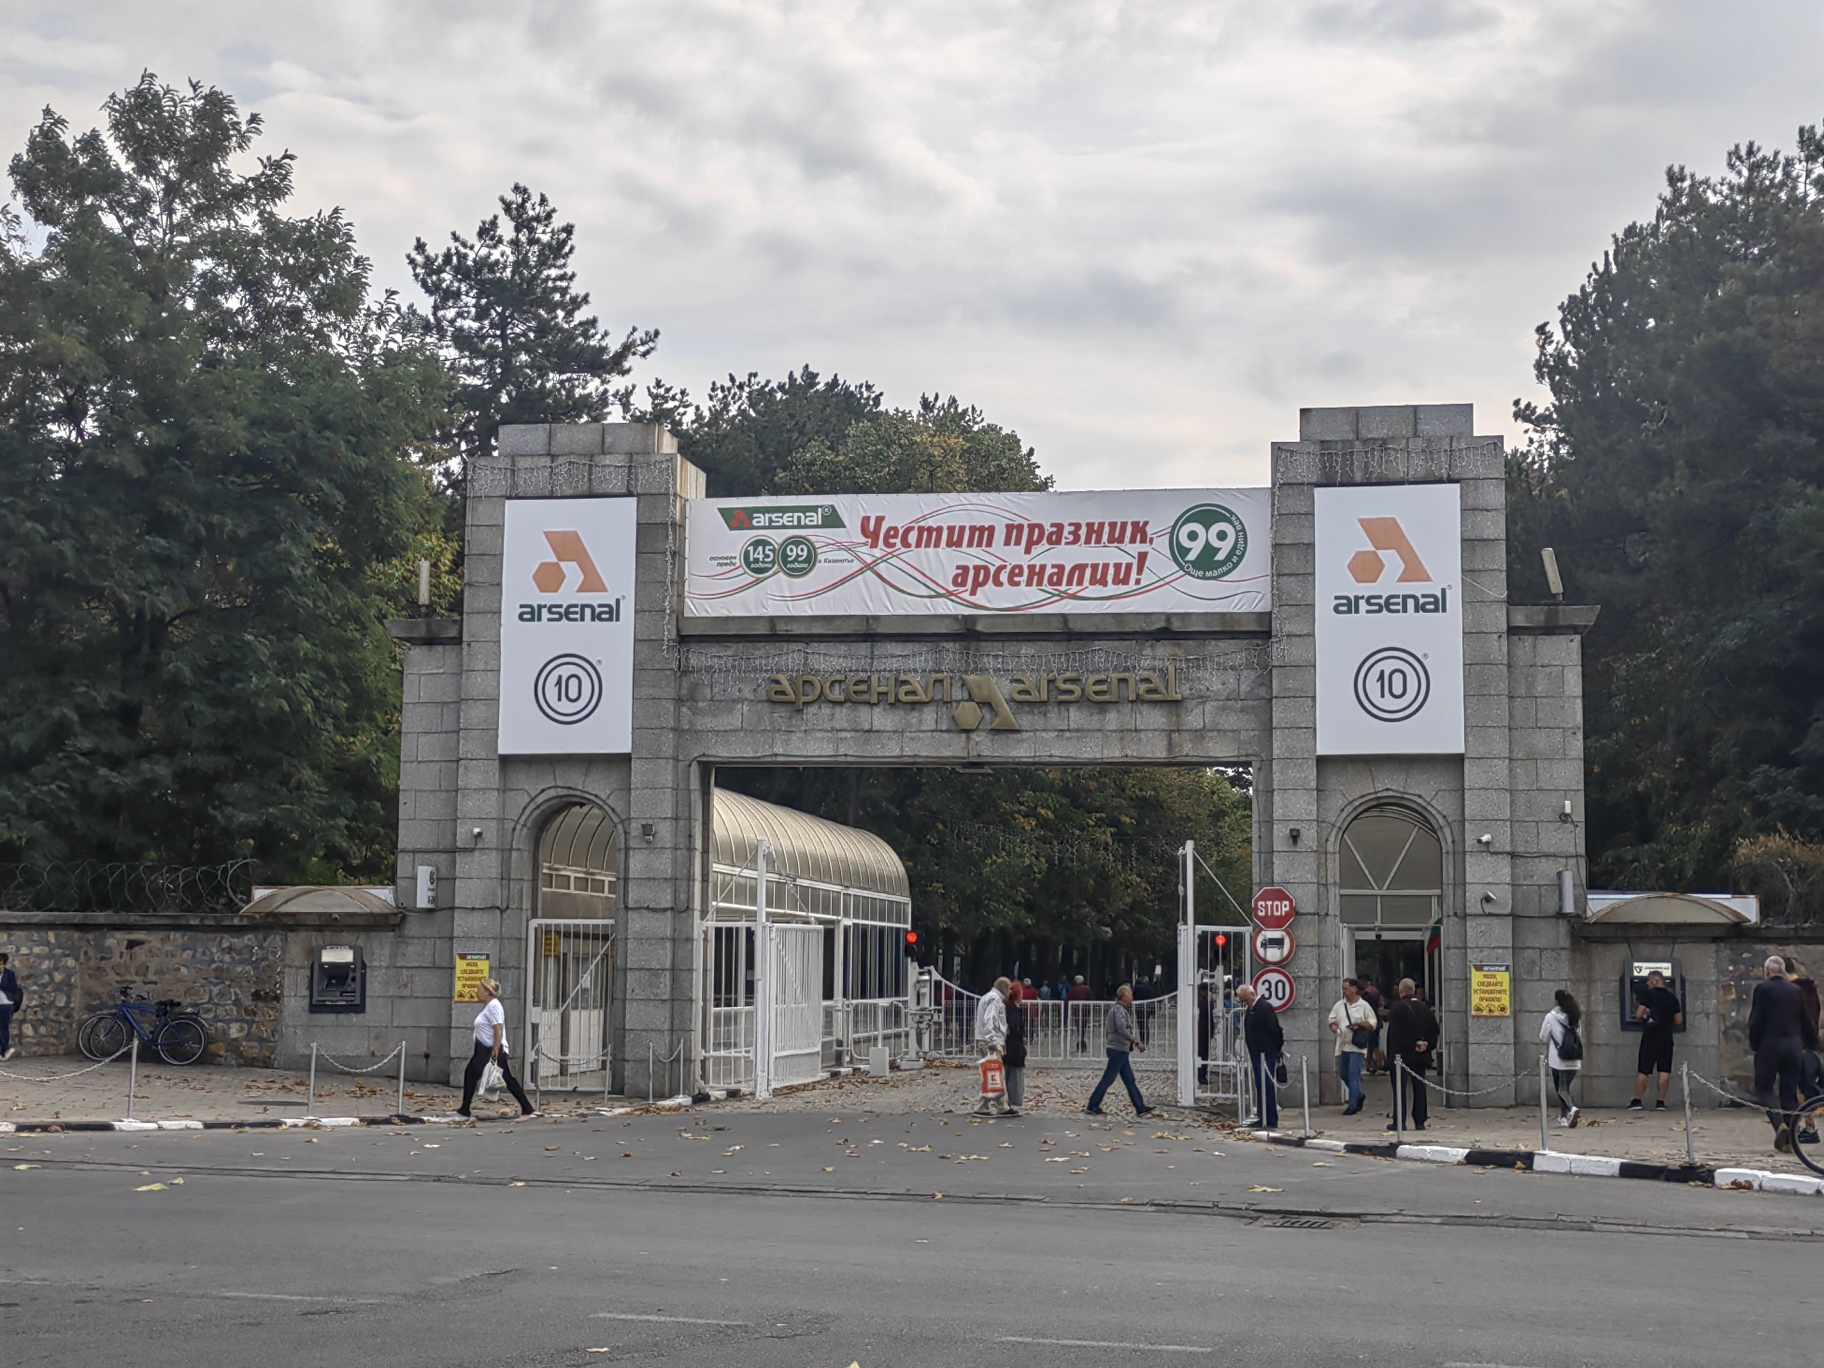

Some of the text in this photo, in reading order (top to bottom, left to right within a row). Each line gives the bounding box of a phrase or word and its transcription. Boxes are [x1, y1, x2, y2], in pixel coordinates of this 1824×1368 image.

[861, 516, 996, 551] Честит
[1178, 522, 1237, 561] 99
[747, 545, 774, 561] 145
[786, 544, 808, 561] 99
[952, 552, 1148, 596] арсеналци!
[1204, 561, 1233, 577] малко
[518, 598, 621, 623] arsenal
[1333, 587, 1447, 614] arsenal
[554, 674, 582, 703] 10
[767, 672, 952, 708] арсенал
[1010, 661, 1183, 703] arsenal
[1376, 668, 1408, 699] 10
[1257, 900, 1290, 917] STOP
[1261, 979, 1286, 1001] 30
